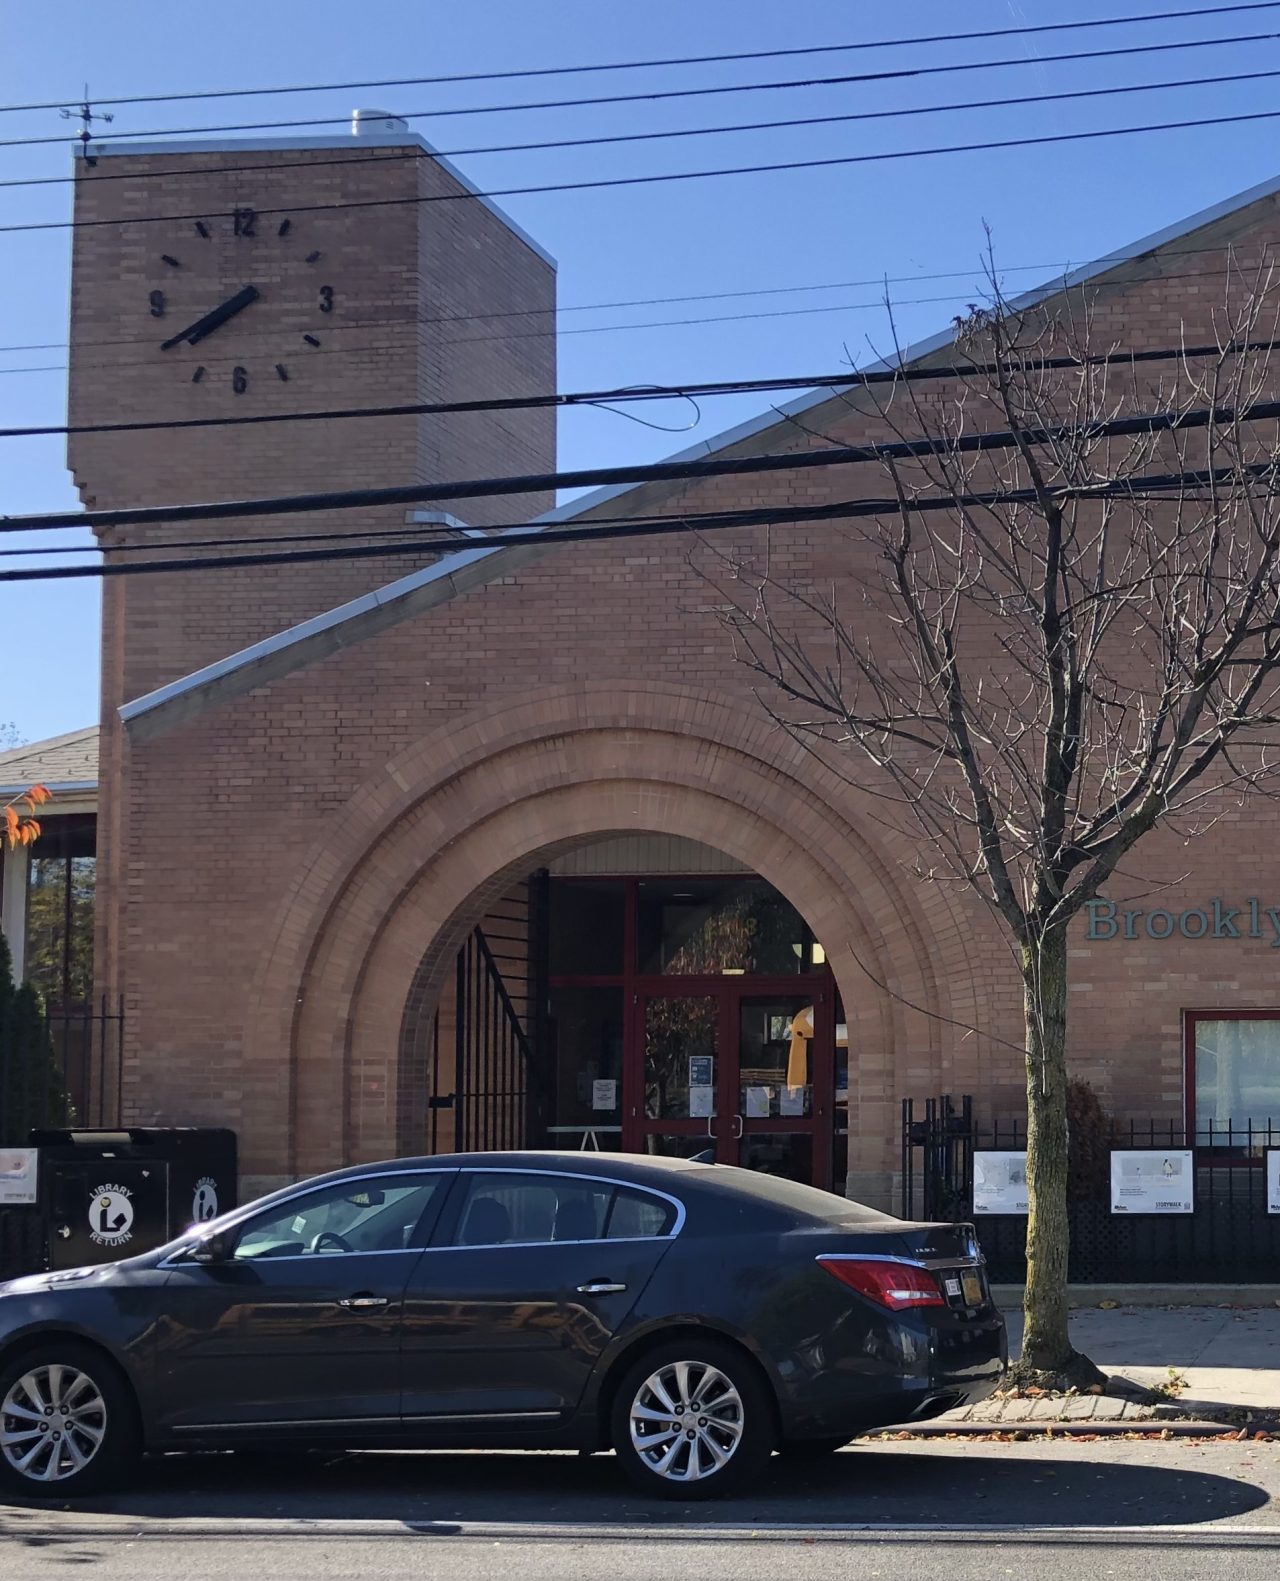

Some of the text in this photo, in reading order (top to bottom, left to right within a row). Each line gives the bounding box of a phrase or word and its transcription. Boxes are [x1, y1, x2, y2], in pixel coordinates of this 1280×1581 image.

[233, 208, 256, 236] 12
[149, 289, 165, 317] 9
[319, 285, 334, 313] 3
[233, 366, 248, 394] 6
[89, 1183, 133, 1200] LIBRARY
[90, 1231, 132, 1246] RETURN
